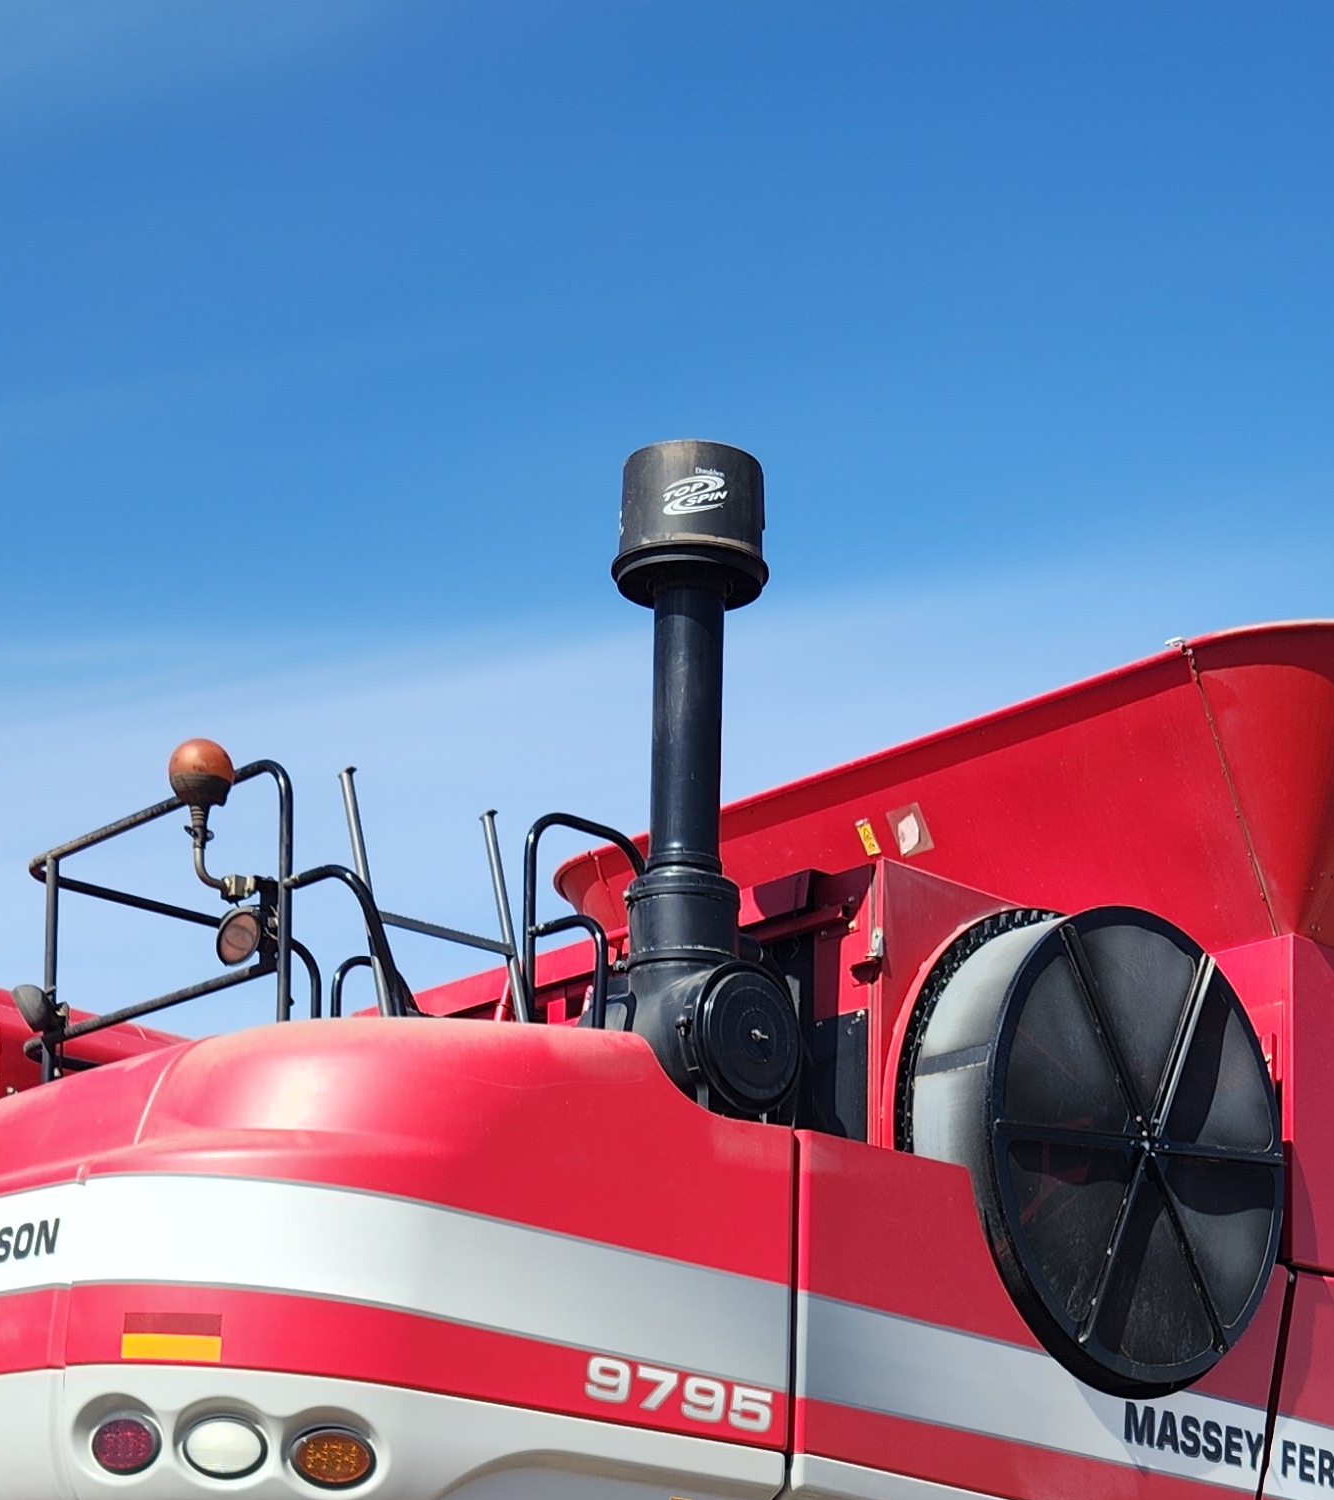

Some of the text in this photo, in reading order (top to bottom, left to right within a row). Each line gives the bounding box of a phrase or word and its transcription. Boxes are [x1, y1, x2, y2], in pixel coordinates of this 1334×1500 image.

[695, 467, 725, 478] Donaldson
[663, 482, 704, 501] TOP
[685, 490, 728, 506] SPIN
[585, 1354, 774, 1433] 9795
[1124, 1400, 1265, 1472] MASSEY
